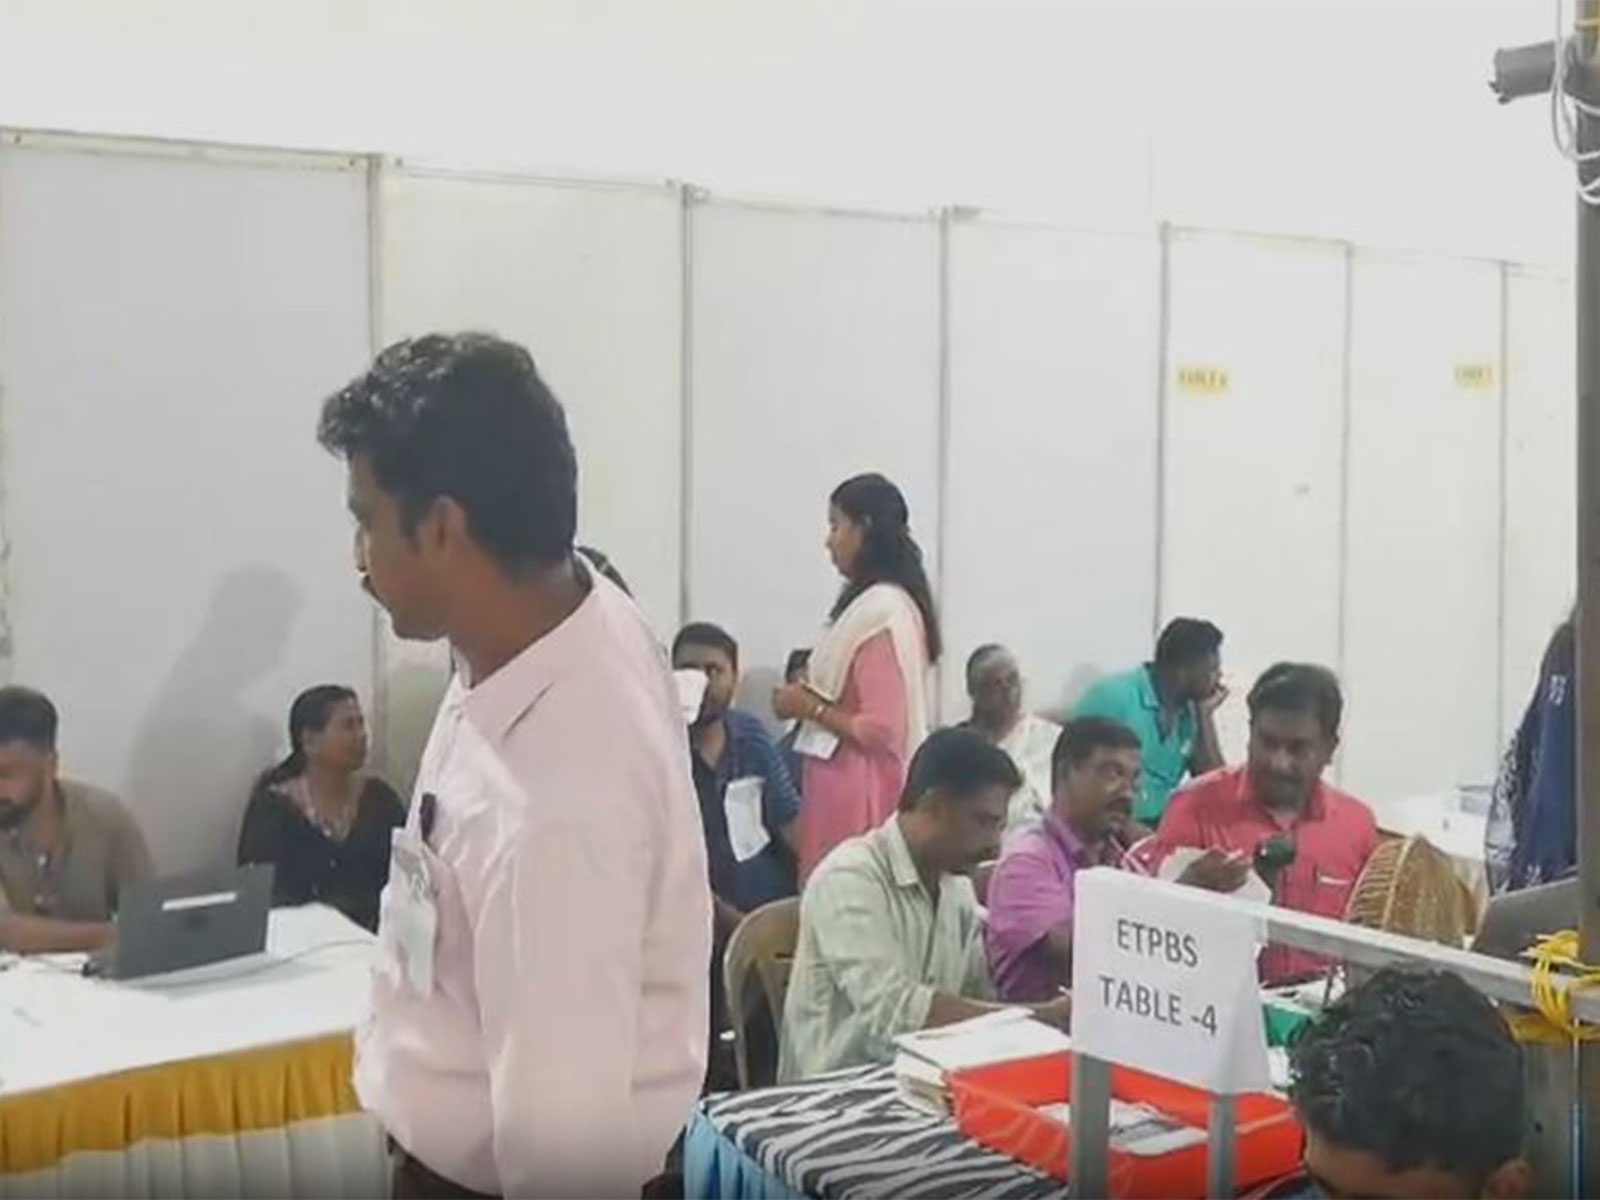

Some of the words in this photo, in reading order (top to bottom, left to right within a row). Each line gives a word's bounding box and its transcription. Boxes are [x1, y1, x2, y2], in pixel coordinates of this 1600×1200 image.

[1117, 919, 1198, 968] ETPBS
[1099, 975, 1182, 1026] TABLE
[1191, 1004, 1218, 1036] -4
